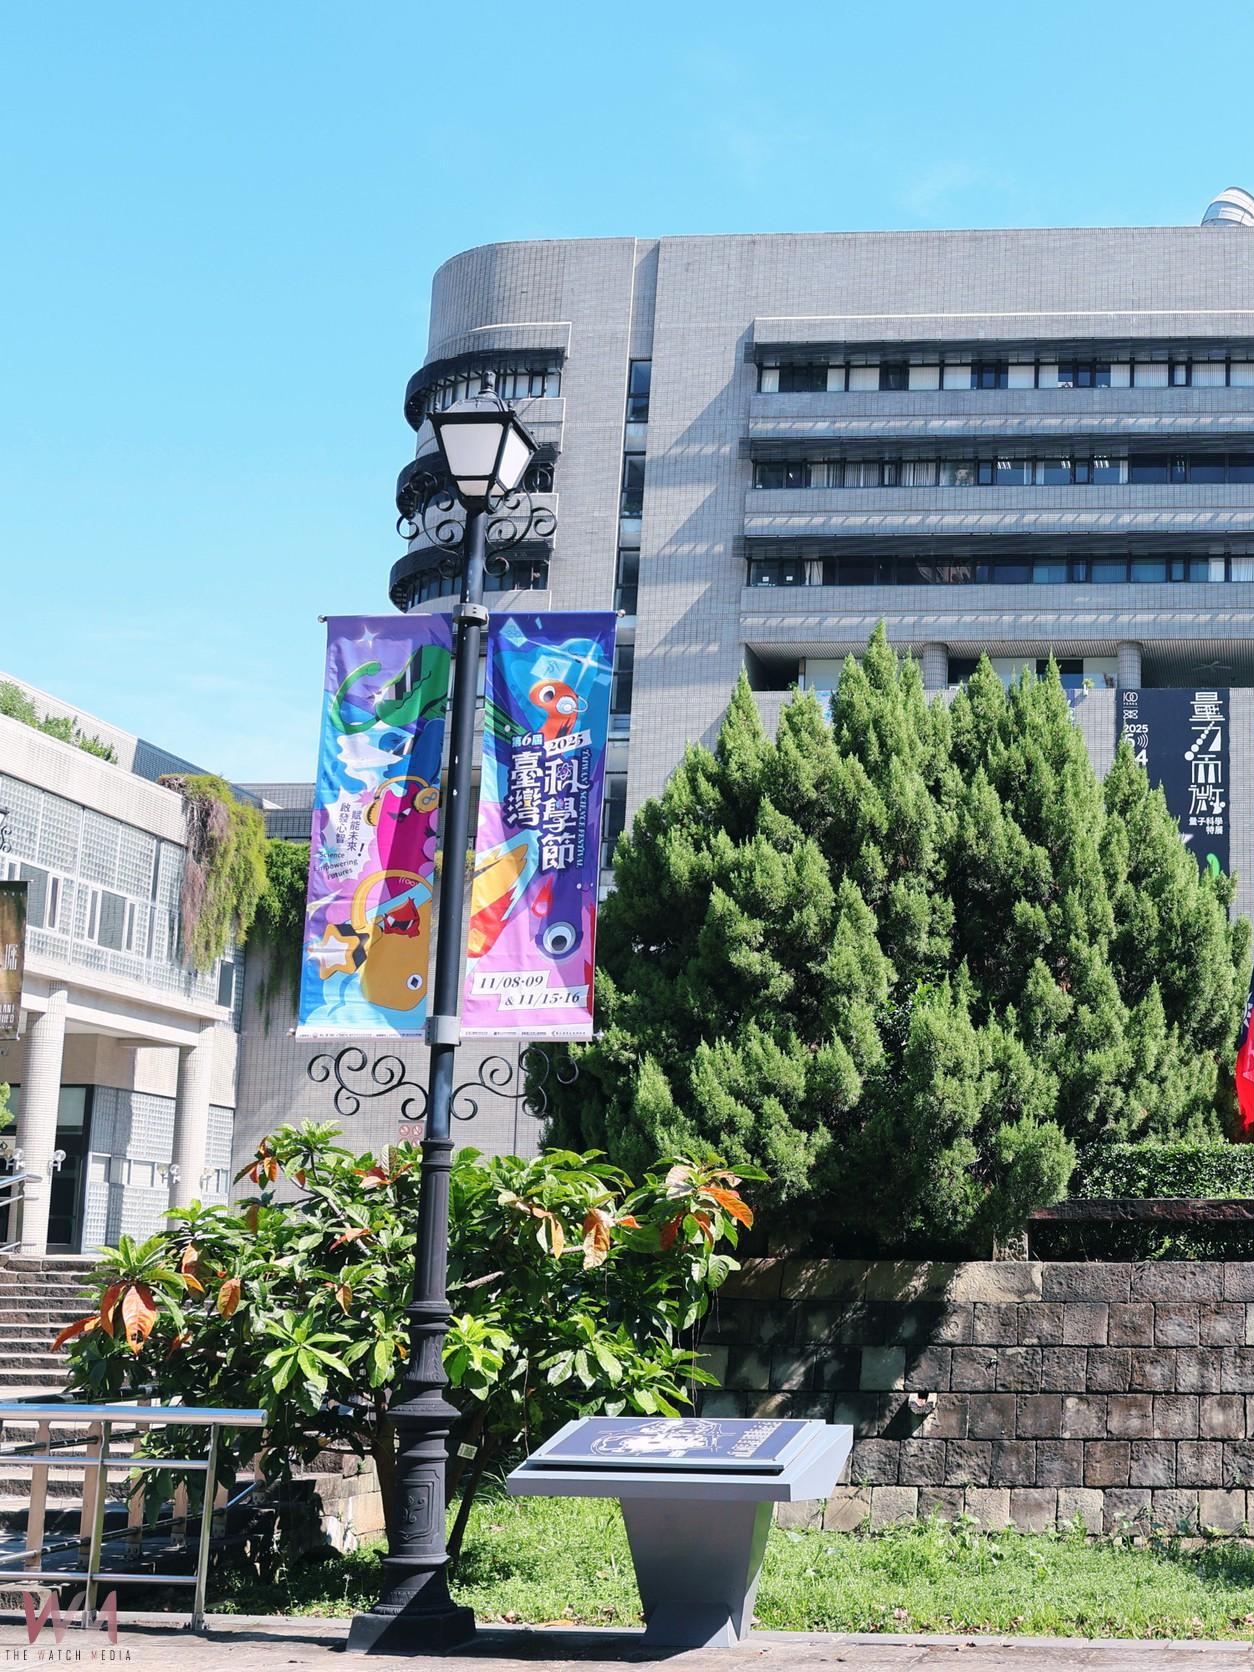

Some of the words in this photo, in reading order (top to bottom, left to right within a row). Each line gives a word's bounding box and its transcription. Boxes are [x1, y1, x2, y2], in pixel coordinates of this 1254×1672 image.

[1124, 724, 1149, 733] 2025
[549, 734, 584, 752] 2025
[507, 751, 544, 826] 臺灣
[541, 758, 584, 871] 科學節
[319, 851, 345, 859] Science
